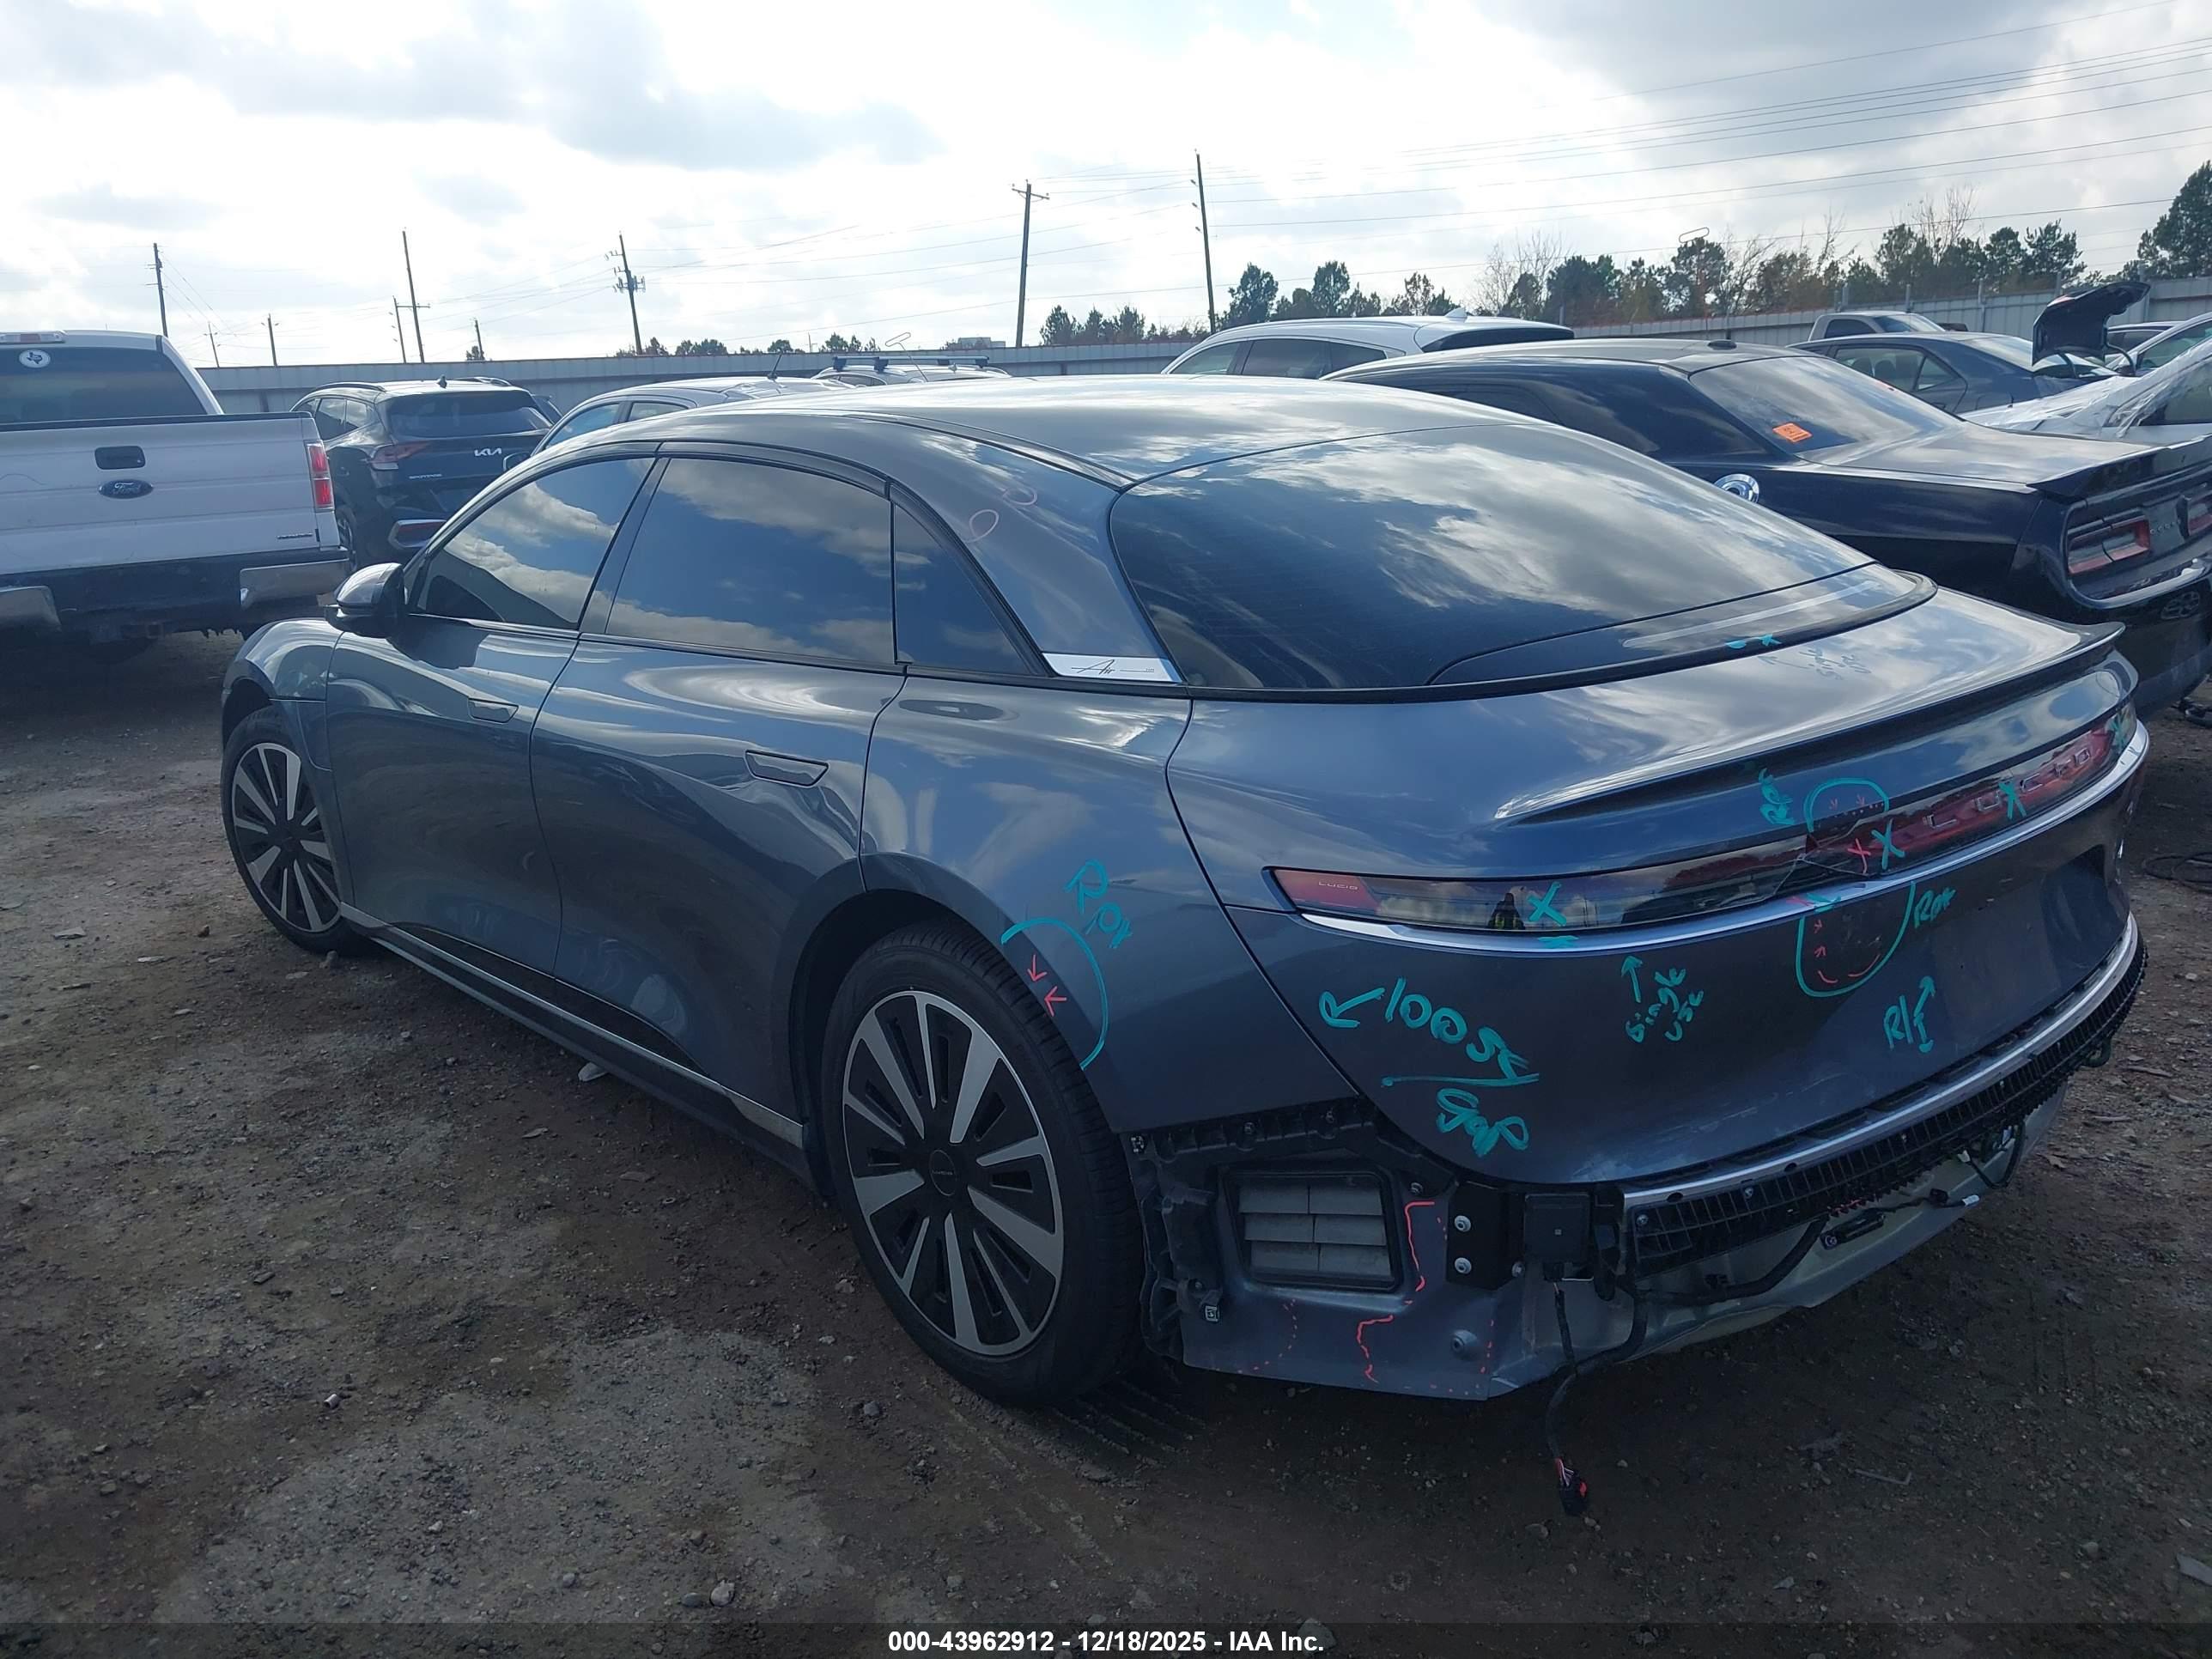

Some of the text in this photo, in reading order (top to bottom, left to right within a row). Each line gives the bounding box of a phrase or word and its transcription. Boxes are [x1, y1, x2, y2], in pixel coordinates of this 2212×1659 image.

[474, 447, 502, 457] KIA
[1923, 746, 2090, 830] LUCID
[1318, 880, 1358, 890] LUCID
